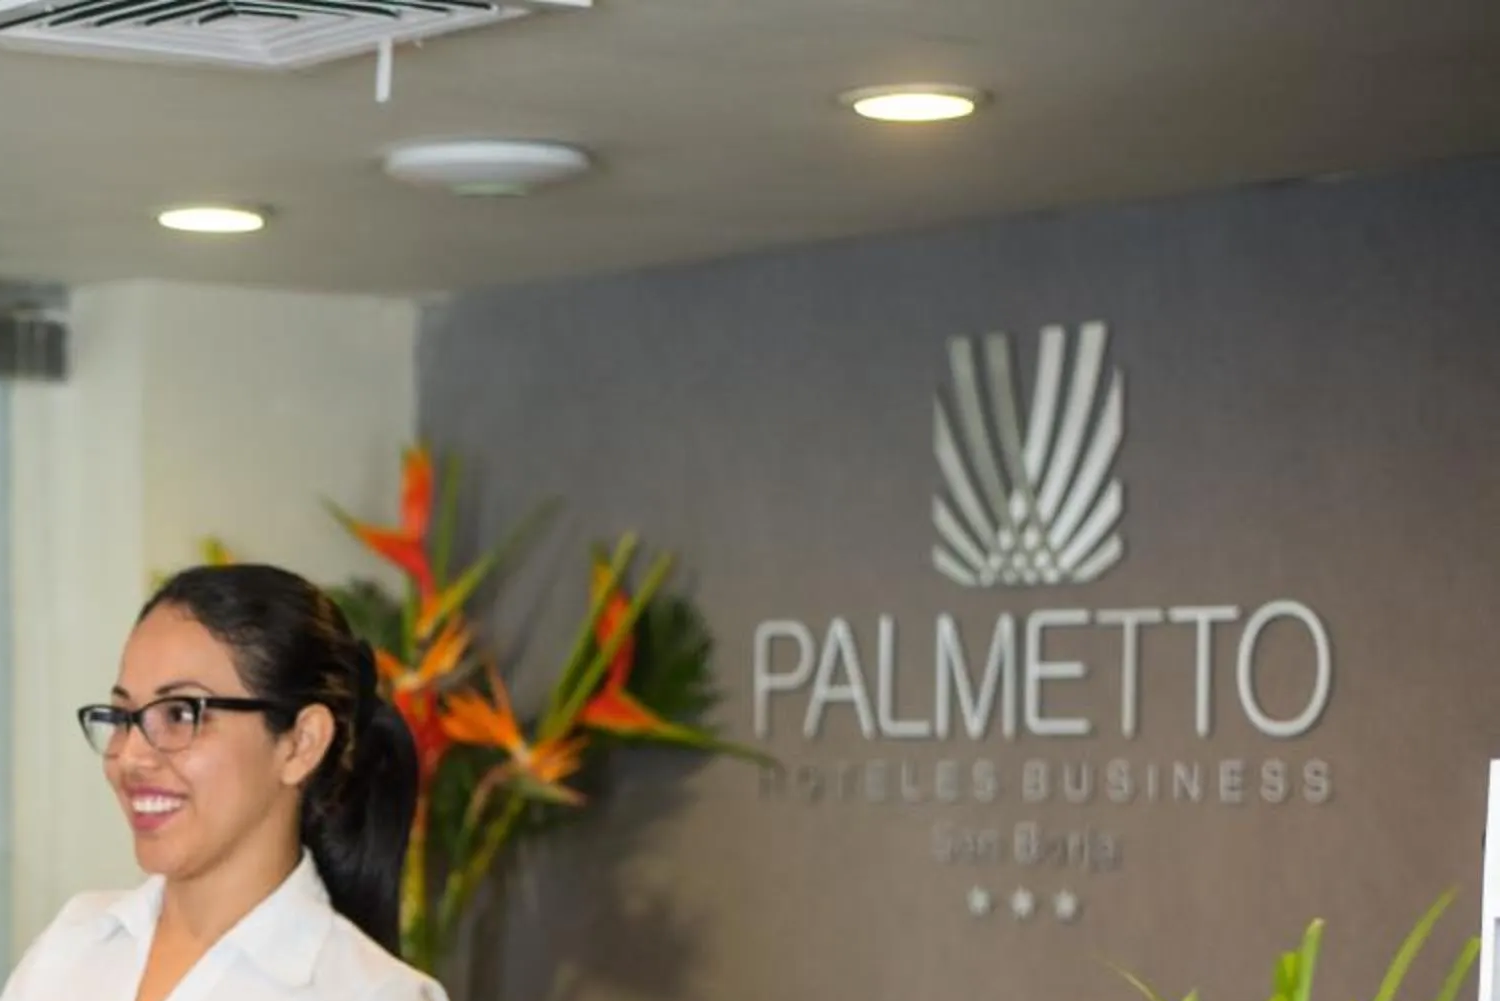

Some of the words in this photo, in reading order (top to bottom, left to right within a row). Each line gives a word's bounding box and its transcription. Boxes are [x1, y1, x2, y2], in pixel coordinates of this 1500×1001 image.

[753, 600, 1332, 738] PALMETTO
[757, 758, 998, 803] HOTELES
[1021, 758, 1332, 804] BUSINESS
